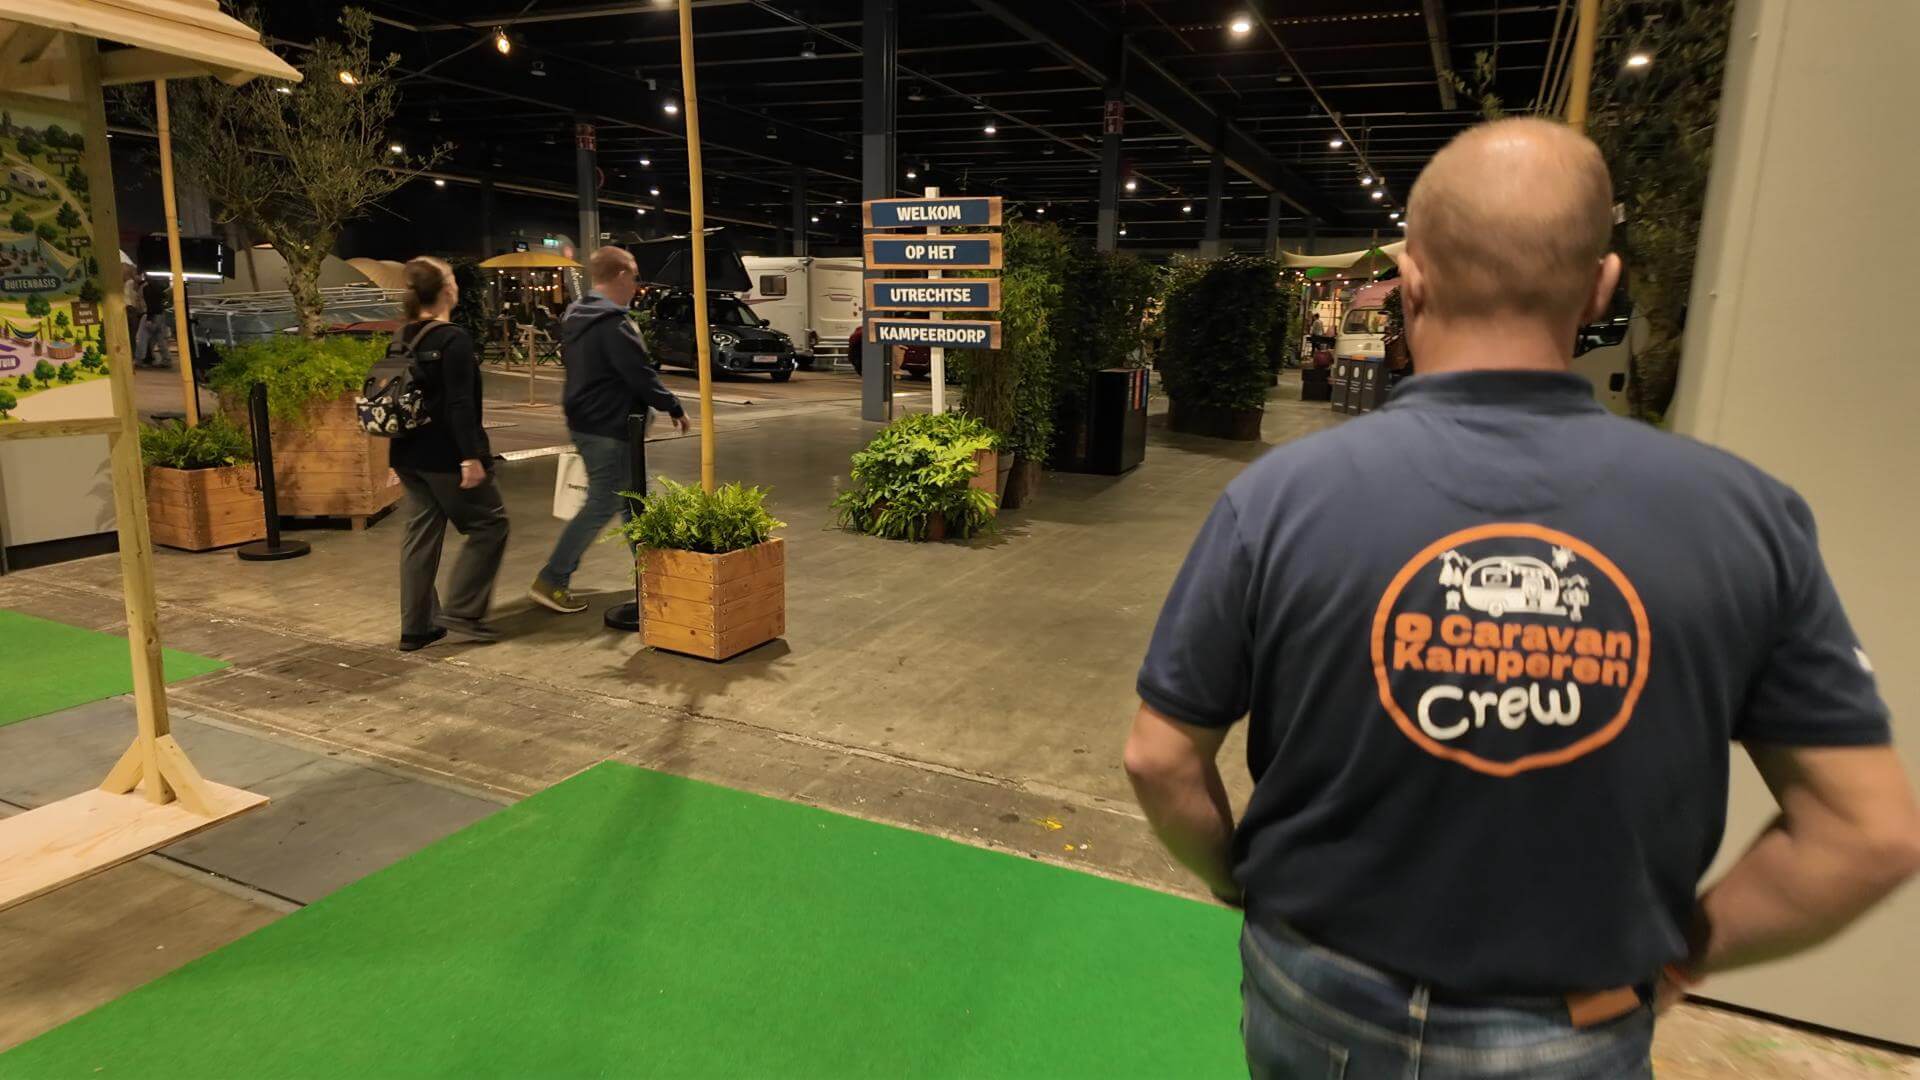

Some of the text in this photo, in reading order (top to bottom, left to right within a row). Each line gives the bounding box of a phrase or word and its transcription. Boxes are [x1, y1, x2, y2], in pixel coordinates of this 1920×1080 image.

[896, 205, 961, 221] WELKOM
[905, 245, 956, 259] OP HET
[890, 288, 971, 302] UTRECHTSE
[879, 326, 986, 343] KAMPEERDORP
[1440, 614, 1632, 660] Caravan
[1393, 640, 1629, 688] Kamperen
[1417, 681, 1581, 740] Crew
